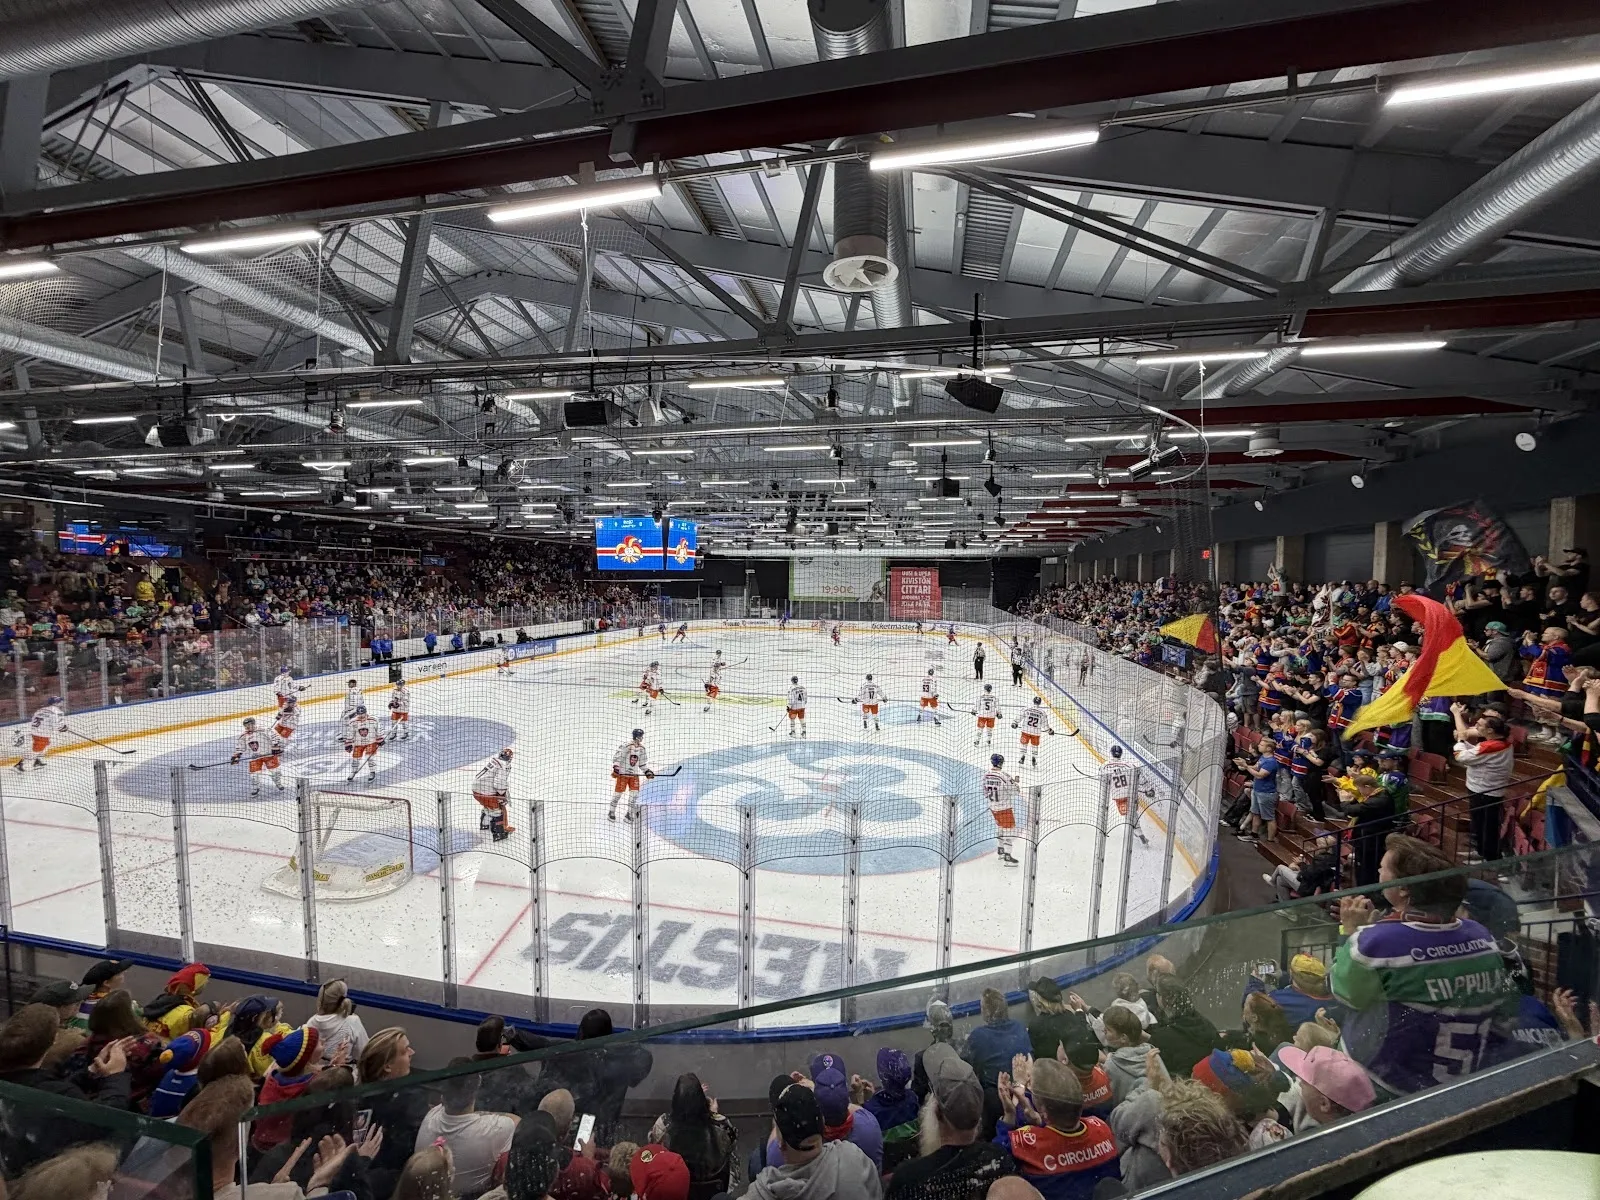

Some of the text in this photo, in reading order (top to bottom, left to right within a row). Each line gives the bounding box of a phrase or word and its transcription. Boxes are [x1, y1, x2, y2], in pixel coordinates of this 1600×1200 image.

[901, 585, 931, 595] CITTARI
[985, 702, 990, 710] 5
[1027, 716, 1039, 727] 22
[1112, 774, 1128, 788] 28
[1426, 938, 1490, 958] CIRCULATION
[1057, 1139, 1114, 1166] CIRCULATION
